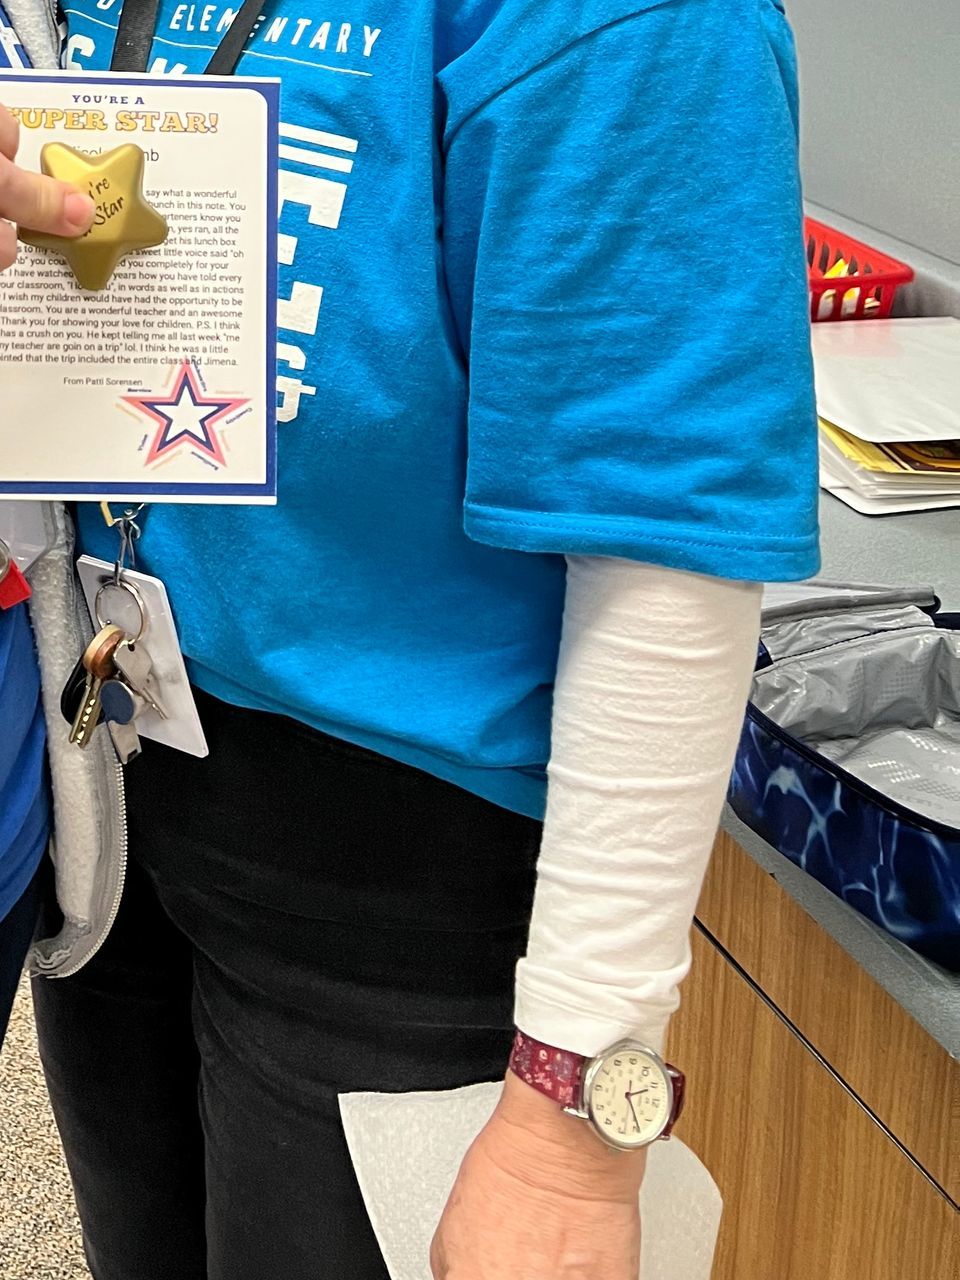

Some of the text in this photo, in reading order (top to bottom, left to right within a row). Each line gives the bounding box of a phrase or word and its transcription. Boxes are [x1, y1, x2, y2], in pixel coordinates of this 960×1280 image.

[72, 94, 145, 105] YOU'RE A
[115, 110, 219, 134] STAR!
[93, 196, 125, 226] Star
[45, 304, 62, 314] You
[88, 306, 131, 315] wonderful
[134, 306, 167, 316] teacher
[168, 307, 185, 316] and
[0, 316, 27, 326] Thank
[29, 319, 45, 328] you
[47, 317, 60, 326] for
[62, 317, 98, 329] showing
[100, 320, 119, 329] your
[122, 318, 140, 328] love
[142, 318, 154, 328] for
[156, 319, 193, 328] children.
[219, 320, 240, 329] think
[0, 328, 16, 338] has
[18, 330, 24, 338] a
[26, 329, 50, 338] crush
[66, 331, 84, 341] you.
[86, 330, 99, 339] He
[101, 330, 120, 341] kept
[122, 330, 149, 342] telling
[167, 331, 177, 340] all
[179, 331, 195, 341] last
[197, 332, 221, 341] week
[11, 340, 44, 350] teacher
[83, 343, 95, 351] on
[145, 342, 166, 352] think
[168, 342, 179, 352] he
[209, 343, 228, 353] little
[25, 353, 42, 362] that
[44, 353, 59, 362] the
[60, 353, 75, 365] trip
[77, 354, 114, 363] included
[116, 354, 131, 364] the
[133, 355, 158, 364] entire
[160, 355, 183, 365] class
[204, 356, 238, 366] Jimena.
[63, 377, 84, 386] From
[106, 378, 143, 387] Sorensen
